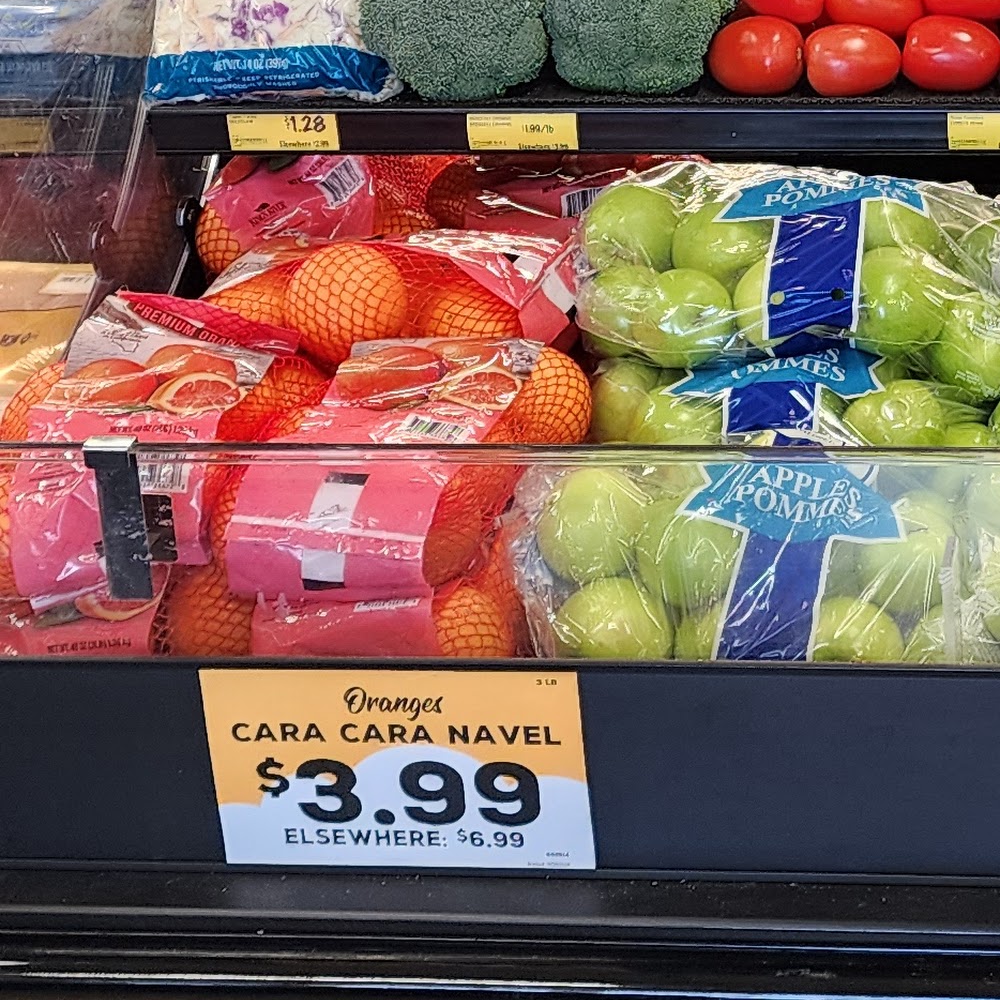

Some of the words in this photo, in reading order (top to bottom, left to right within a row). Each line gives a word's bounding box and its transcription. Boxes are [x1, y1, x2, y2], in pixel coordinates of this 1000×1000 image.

[284, 115, 326, 133] $1.28
[133, 302, 198, 337] PREMIUM
[198, 330, 240, 348] ORAN
[343, 686, 444, 721] Oranges
[231, 722, 326, 743] CARA
[340, 723, 436, 745] CARA
[448, 725, 562, 746] NAVEL
[255, 756, 541, 827] $3.99
[284, 828, 448, 848] ELSEWHERE:
[456, 828, 525, 849] $6.99
